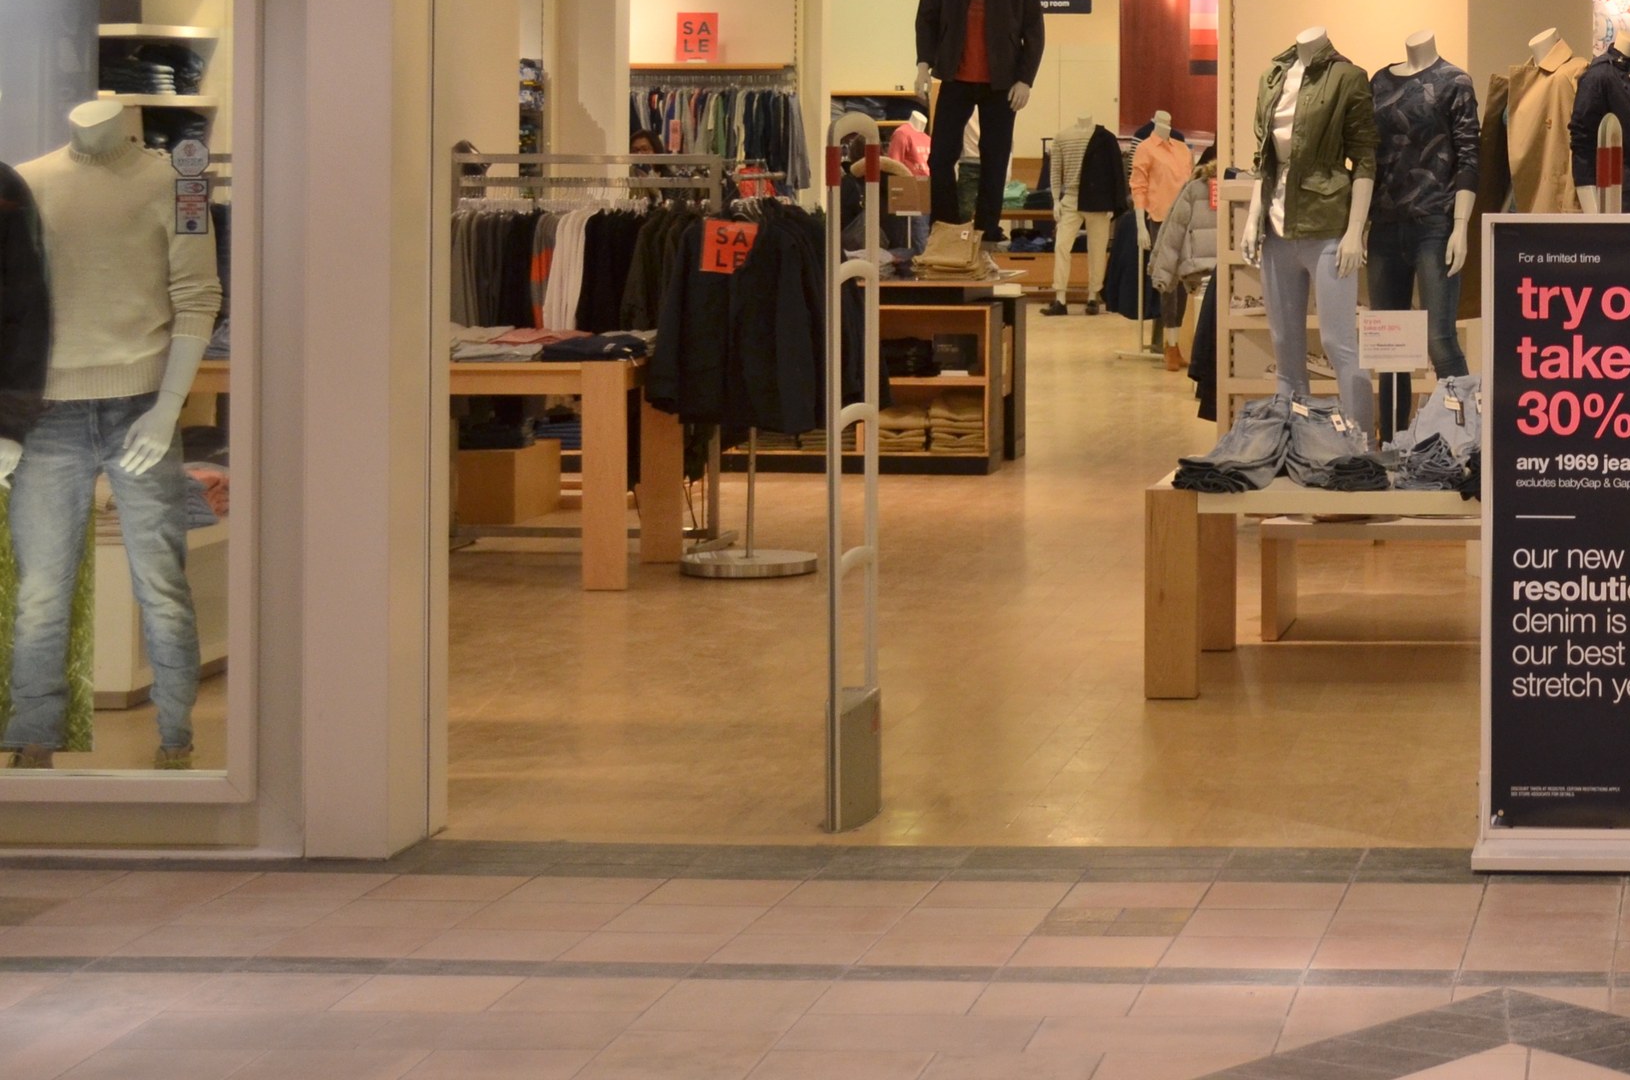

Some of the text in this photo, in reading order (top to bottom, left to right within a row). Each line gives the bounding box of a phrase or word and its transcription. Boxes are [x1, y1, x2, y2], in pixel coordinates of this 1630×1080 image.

[683, 21, 711, 35] SA
[683, 39, 709, 53] LE
[715, 226, 748, 247] SA
[1518, 252, 1601, 263] For a limited time
[1517, 277, 1593, 330] try
[1516, 457, 1550, 474] any
[1555, 454, 1599, 471] 1969
[1516, 477, 1556, 488] excludes
[1558, 477, 1601, 490] babyGap
[1603, 477, 1611, 488] &
[1512, 548, 1625, 569] our new
[1512, 606, 1627, 633] denim is
[1512, 639, 1626, 666] our best
[1512, 671, 1603, 698] stretch
